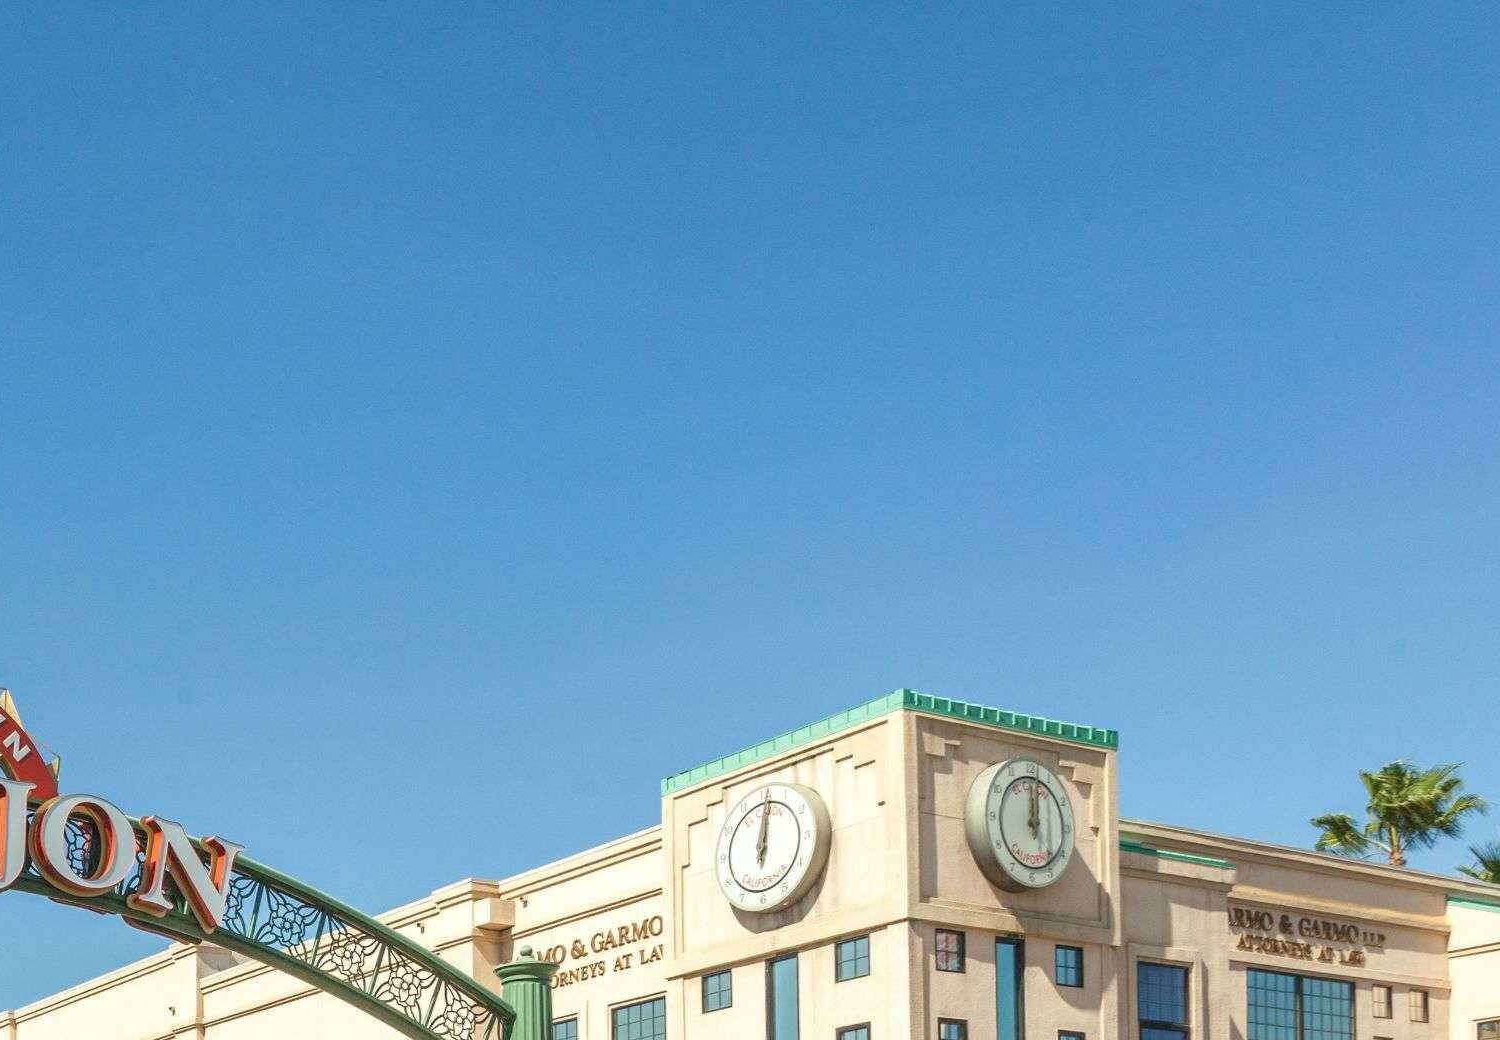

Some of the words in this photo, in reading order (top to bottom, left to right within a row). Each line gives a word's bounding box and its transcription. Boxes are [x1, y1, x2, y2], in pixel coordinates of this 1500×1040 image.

[742, 864, 788, 888] CALIFORNIA
[571, 940, 588, 959] &
[591, 916, 663, 953] GARMO
[1228, 906, 1274, 931] RMO
[1278, 914, 1294, 935] &
[1298, 917, 1359, 944] GARMO
[614, 953, 633, 972] AT
